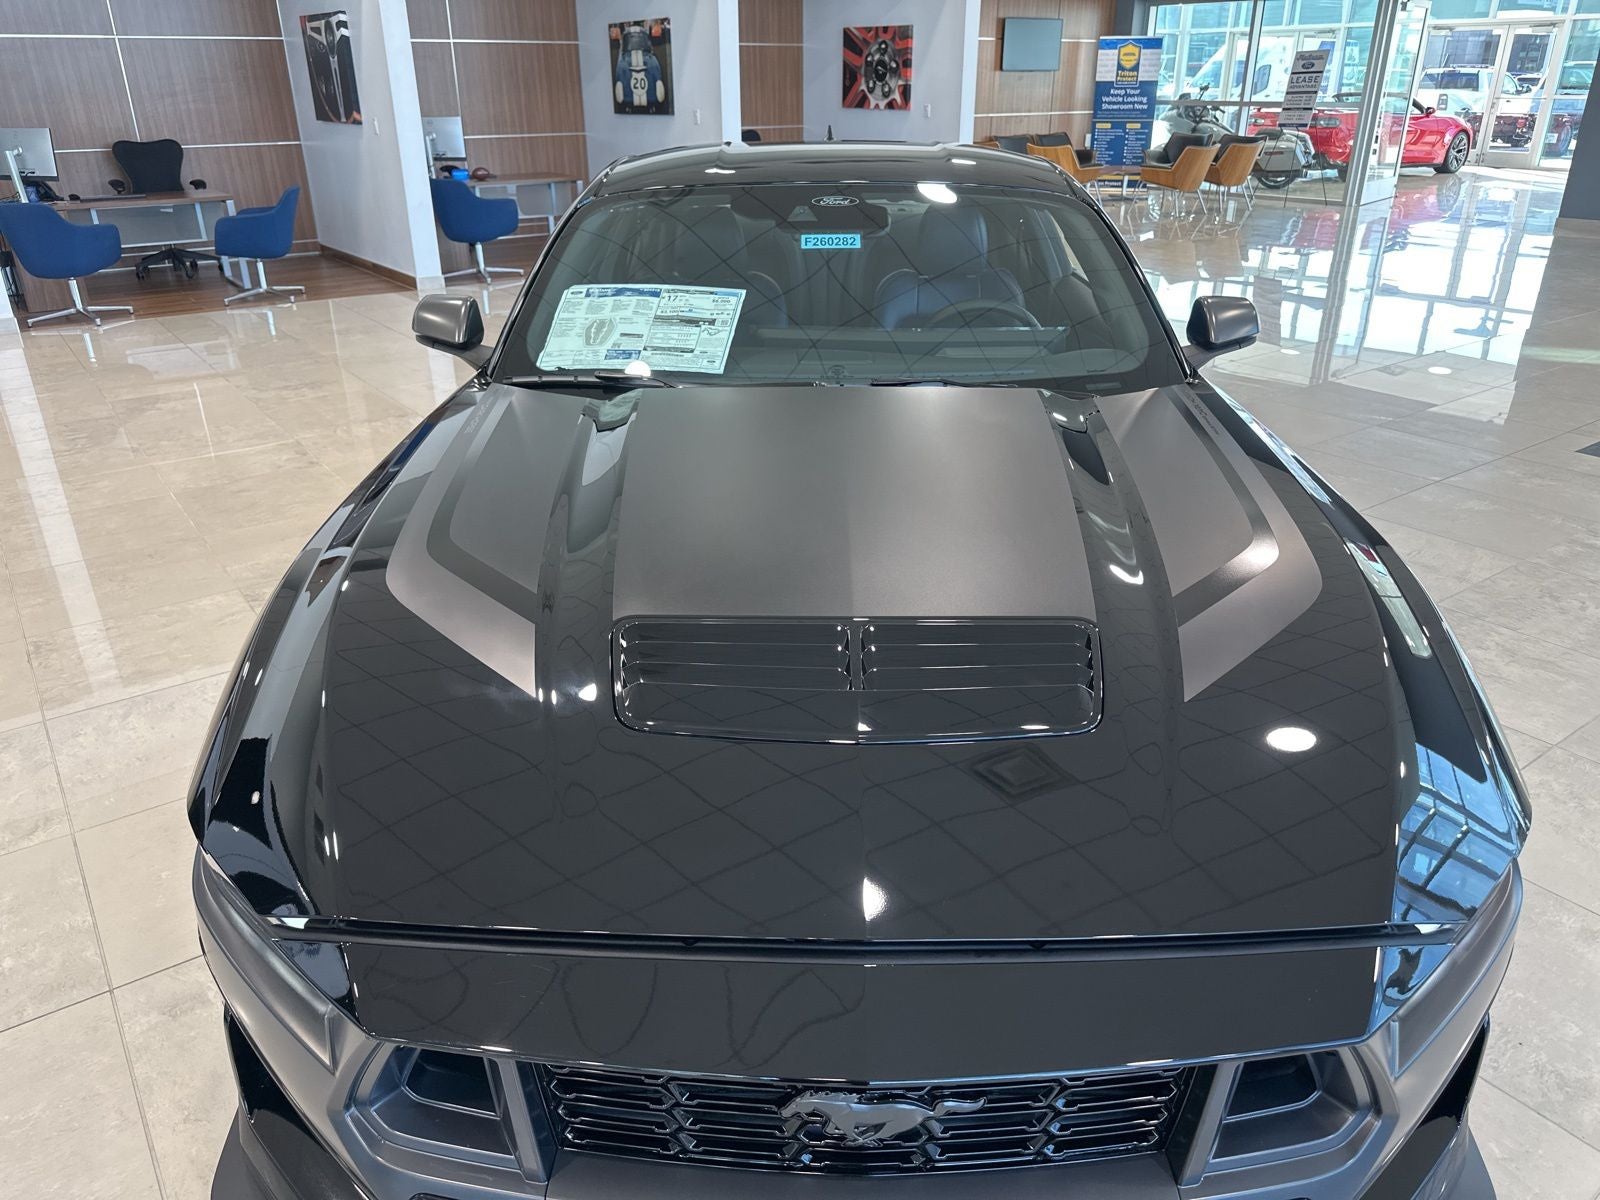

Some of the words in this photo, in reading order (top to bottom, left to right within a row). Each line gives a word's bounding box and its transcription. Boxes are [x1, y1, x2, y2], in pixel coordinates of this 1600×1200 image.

[633, 77, 646, 90] 20
[1291, 75, 1320, 84] LEASE
[820, 195, 851, 205] Ford
[804, 236, 856, 246] F260282
